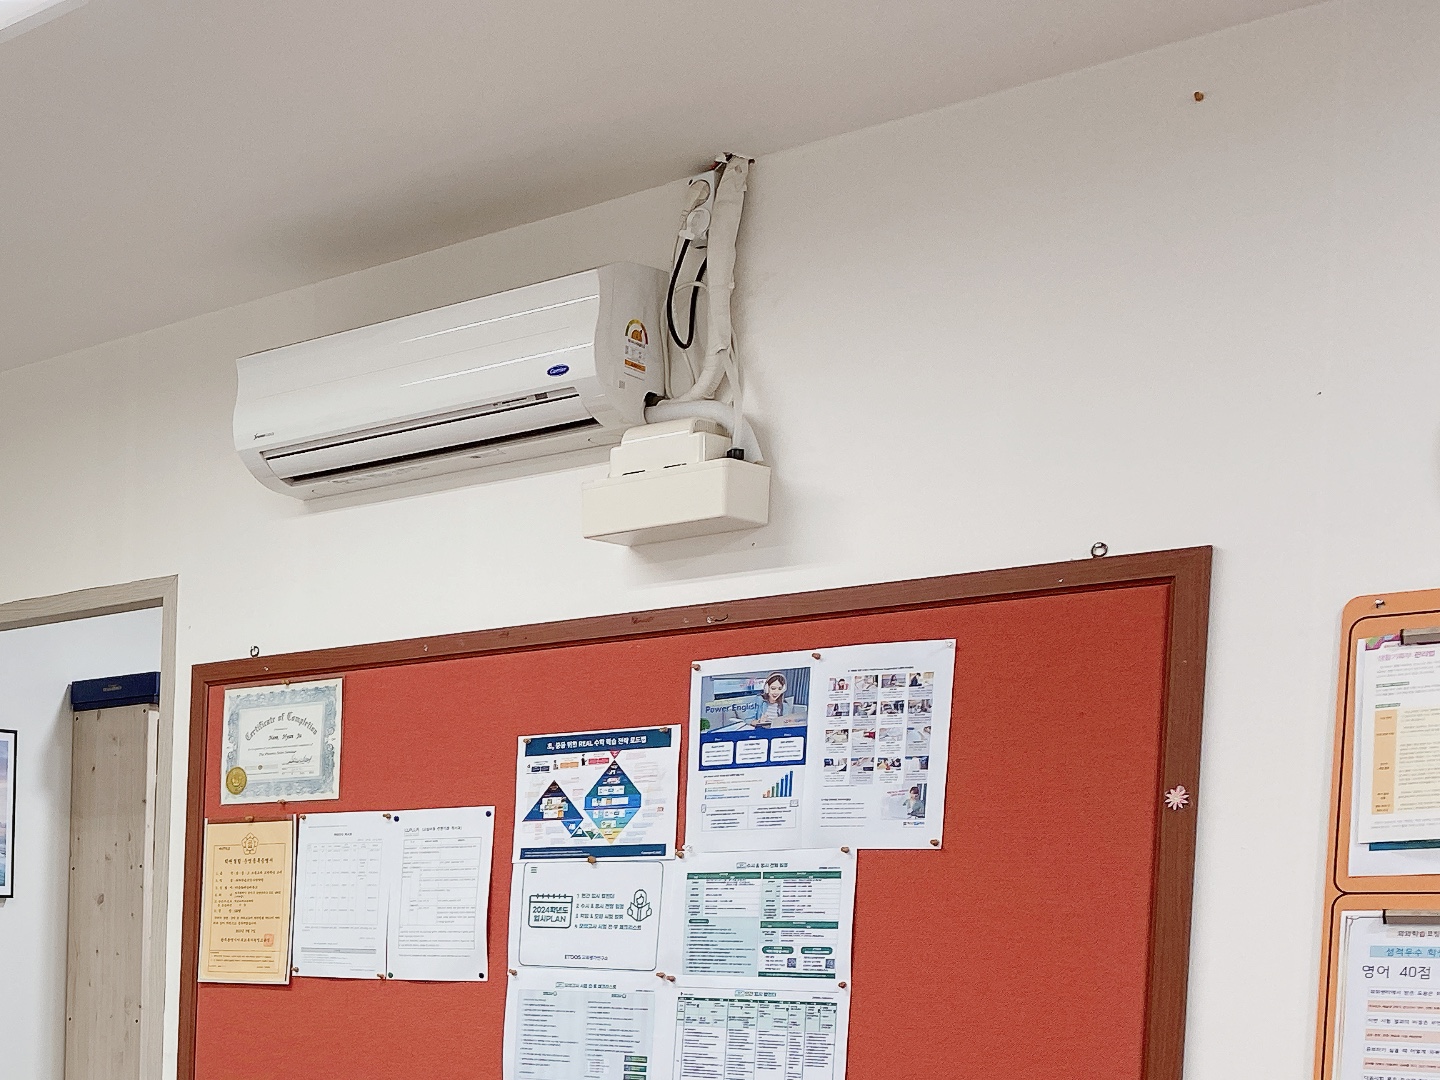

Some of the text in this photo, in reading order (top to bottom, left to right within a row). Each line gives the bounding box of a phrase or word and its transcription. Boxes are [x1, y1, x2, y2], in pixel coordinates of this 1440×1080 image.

[705, 703, 760, 714] Power English
[245, 711, 318, 741] Certificate of Completion
[1362, 965, 1431, 980] 영어 40점
